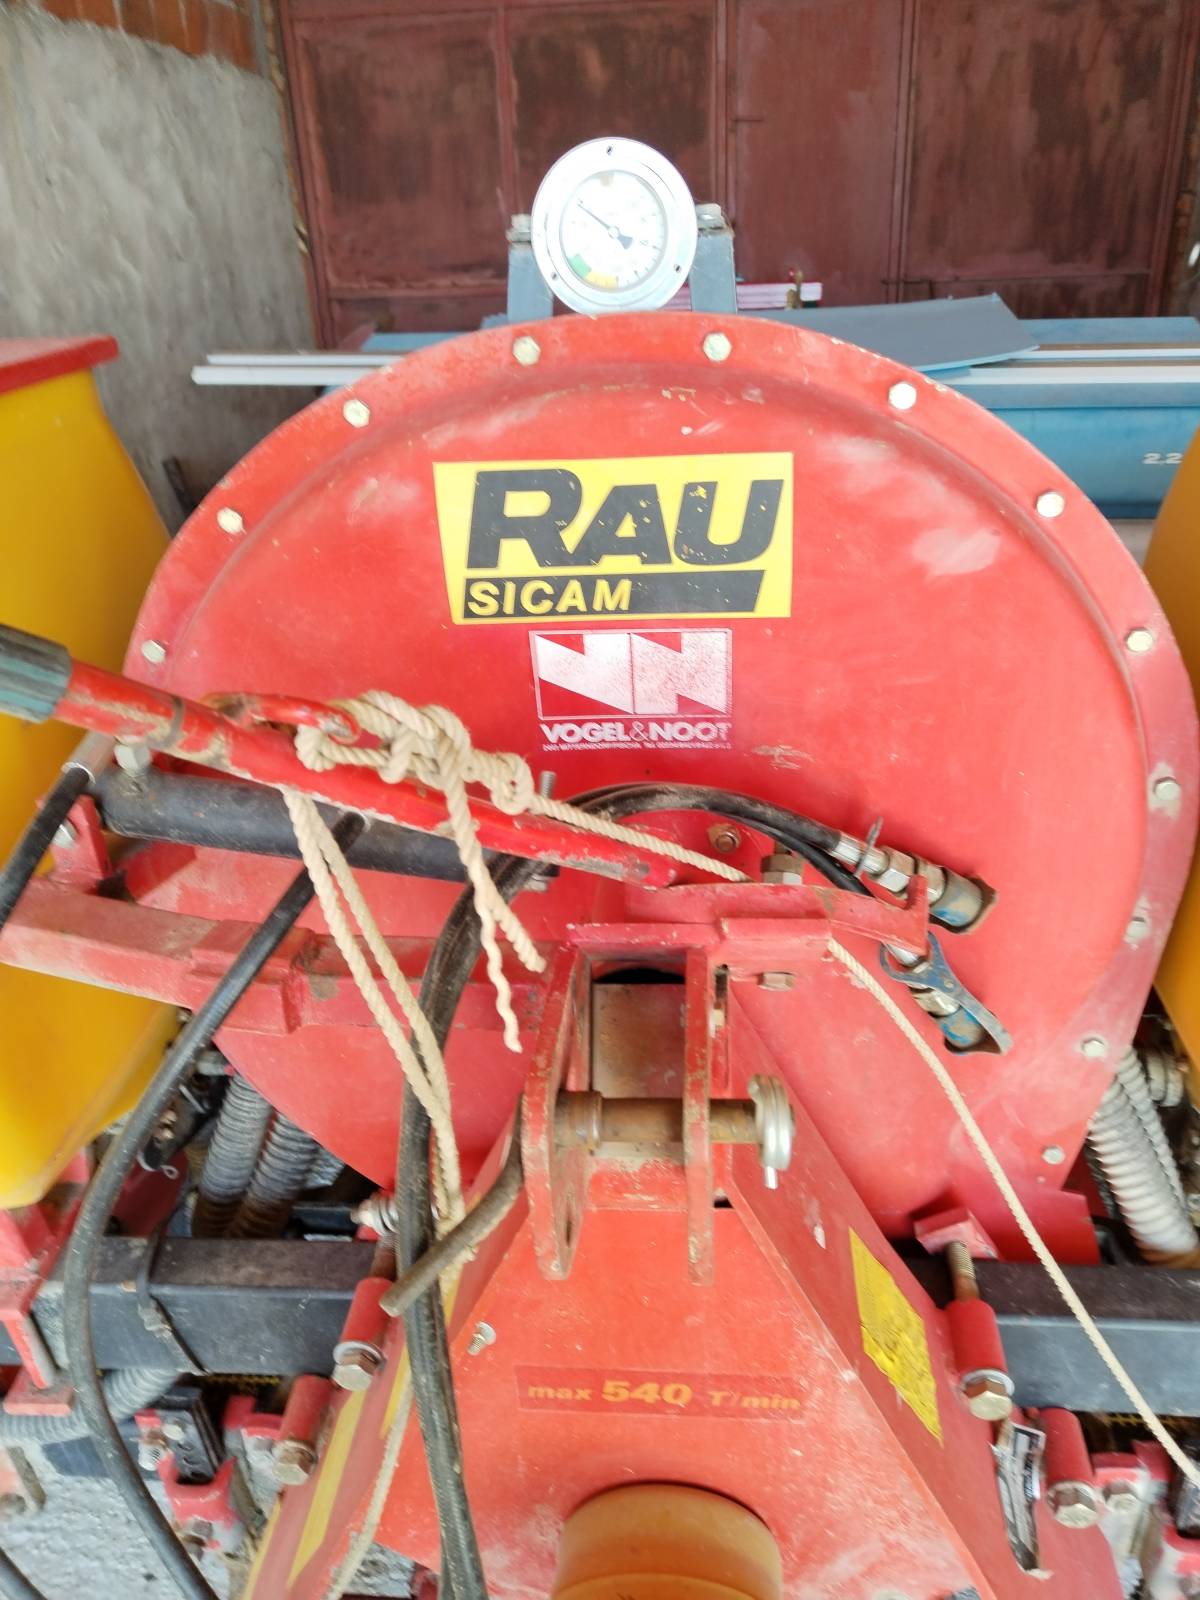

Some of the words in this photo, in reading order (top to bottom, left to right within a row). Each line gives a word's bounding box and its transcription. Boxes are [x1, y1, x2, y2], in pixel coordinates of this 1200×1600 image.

[467, 468, 784, 568] RAU
[467, 578, 632, 616] SICAM
[527, 1385, 592, 1401] max
